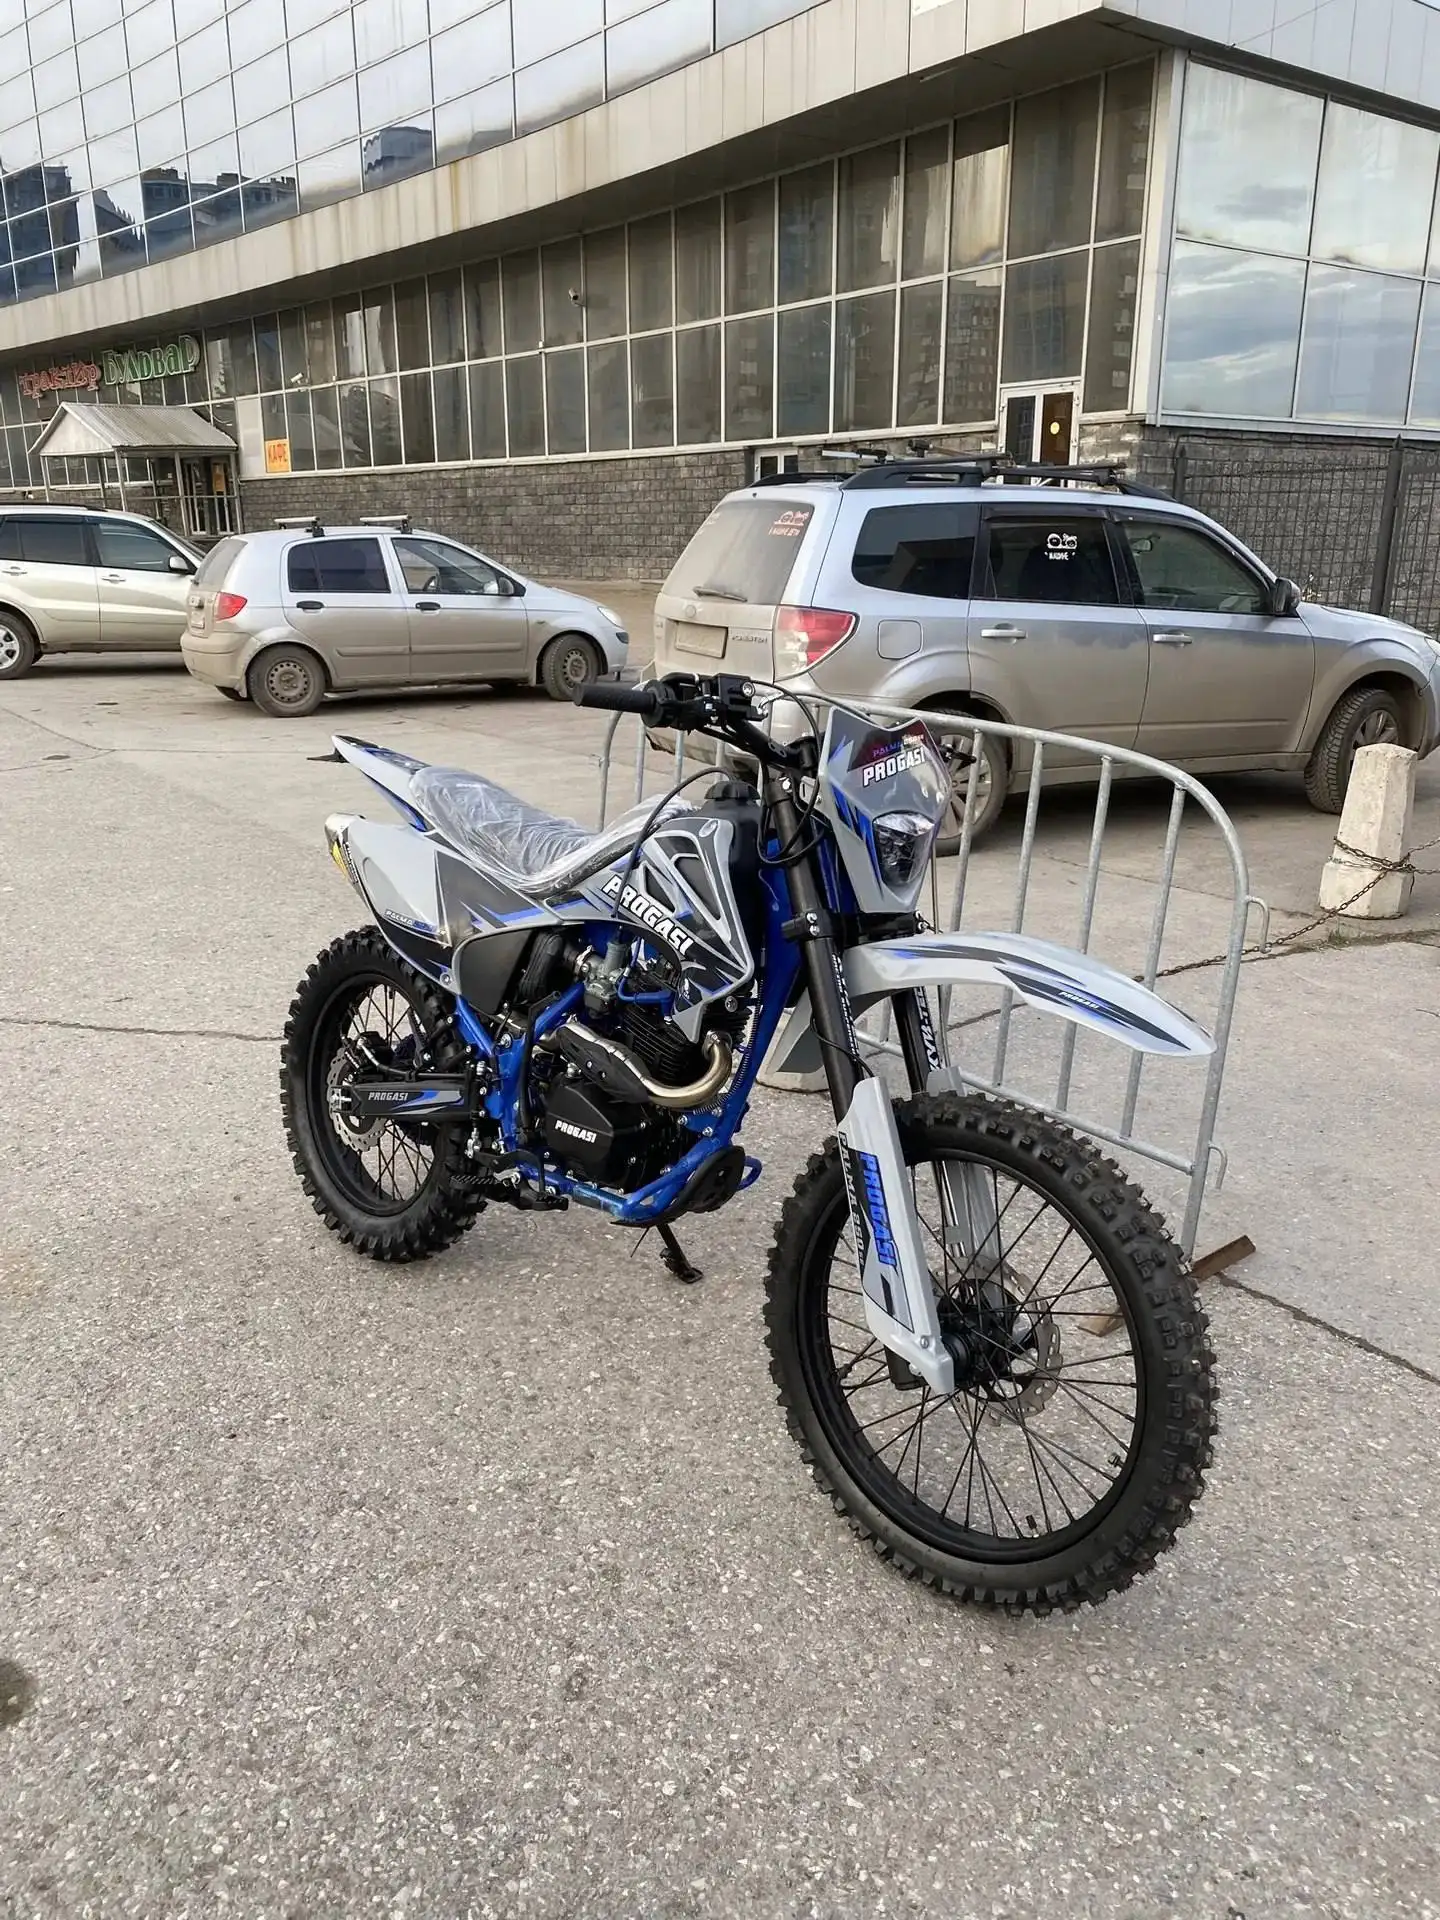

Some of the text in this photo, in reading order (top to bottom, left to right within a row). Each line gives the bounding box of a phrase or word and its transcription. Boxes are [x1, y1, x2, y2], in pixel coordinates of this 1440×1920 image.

[863, 746, 926, 788] PROGASI
[601, 874, 694, 956] PROGASI
[367, 1091, 409, 1101] PROGASI
[554, 1119, 597, 1144] PROGASI
[839, 1132, 858, 1207] PALMA
[859, 1151, 898, 1267] PROGASI
